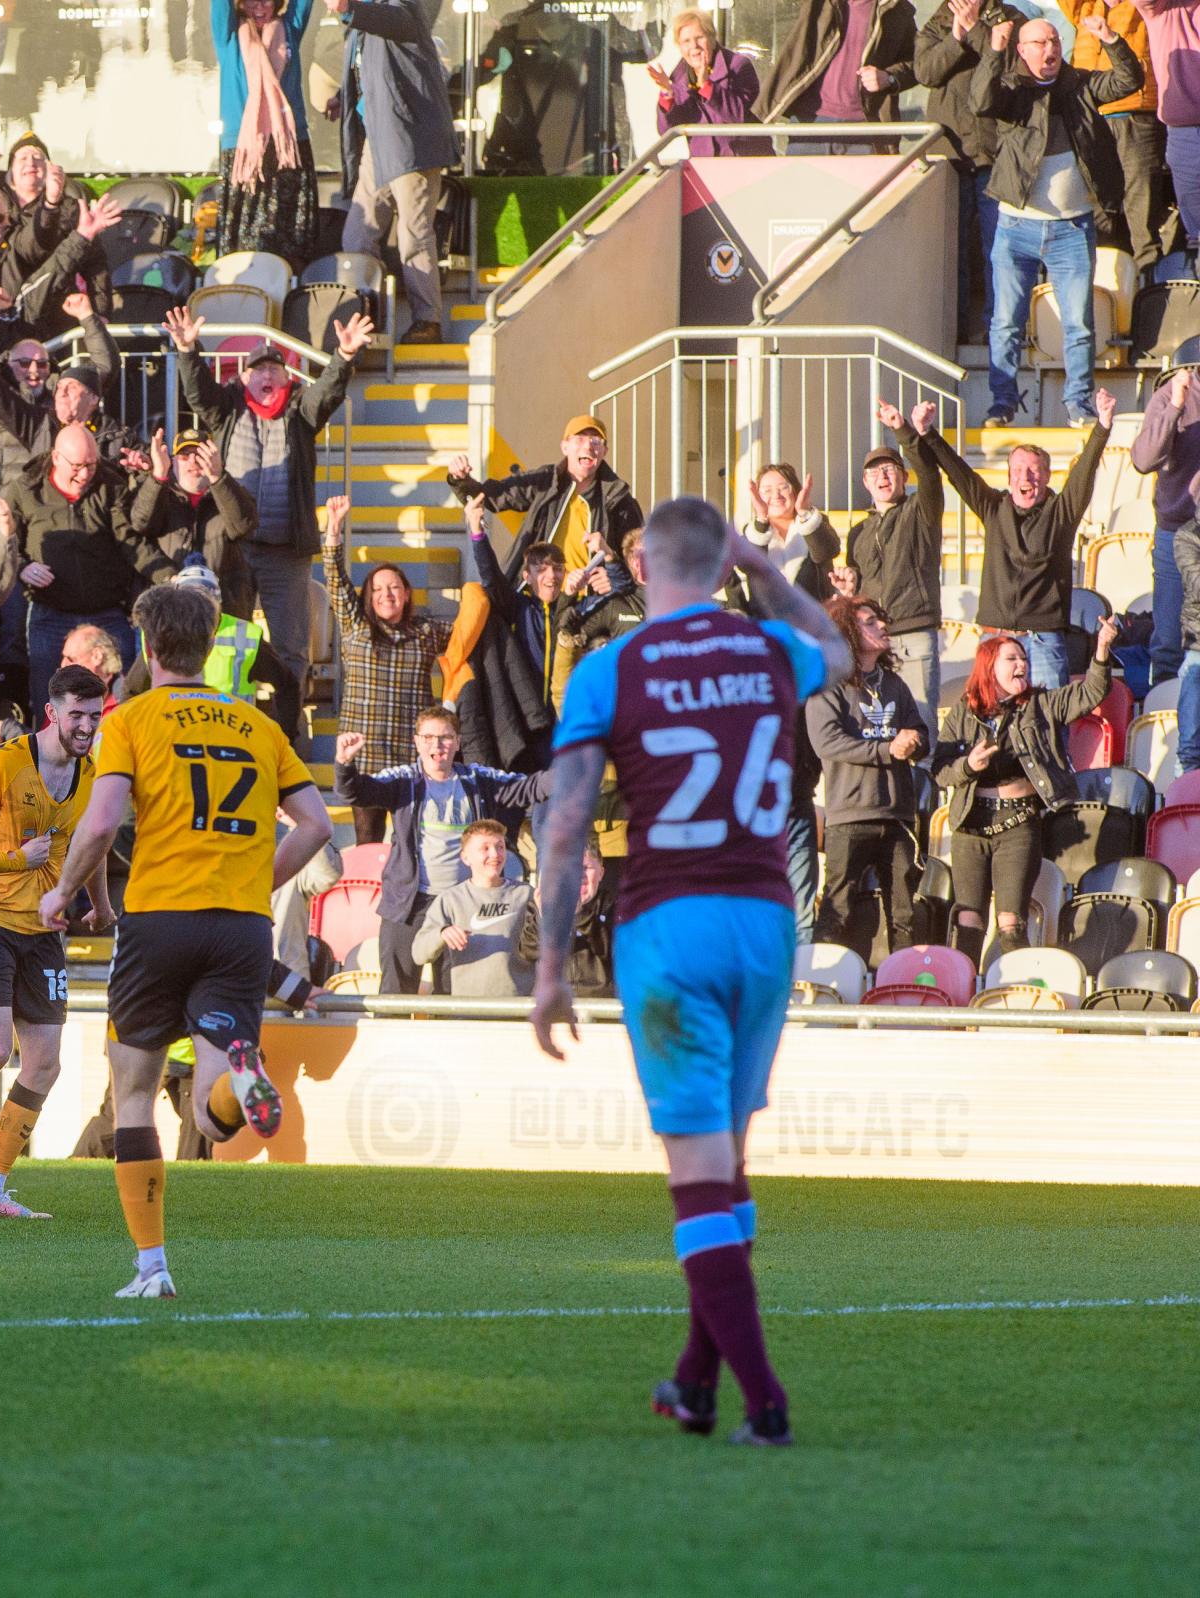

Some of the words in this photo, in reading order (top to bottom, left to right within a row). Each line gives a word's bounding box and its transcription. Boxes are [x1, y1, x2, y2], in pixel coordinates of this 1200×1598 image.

[58, 8, 107, 19] RODNEY
[543, 2, 593, 13] RODNEY
[596, 1, 644, 12] PARADE
[662, 672, 775, 714] CLARKE
[174, 705, 254, 738] FISHER
[173, 744, 258, 836] 12
[641, 714, 794, 847] 26
[479, 903, 510, 917] NIKE
